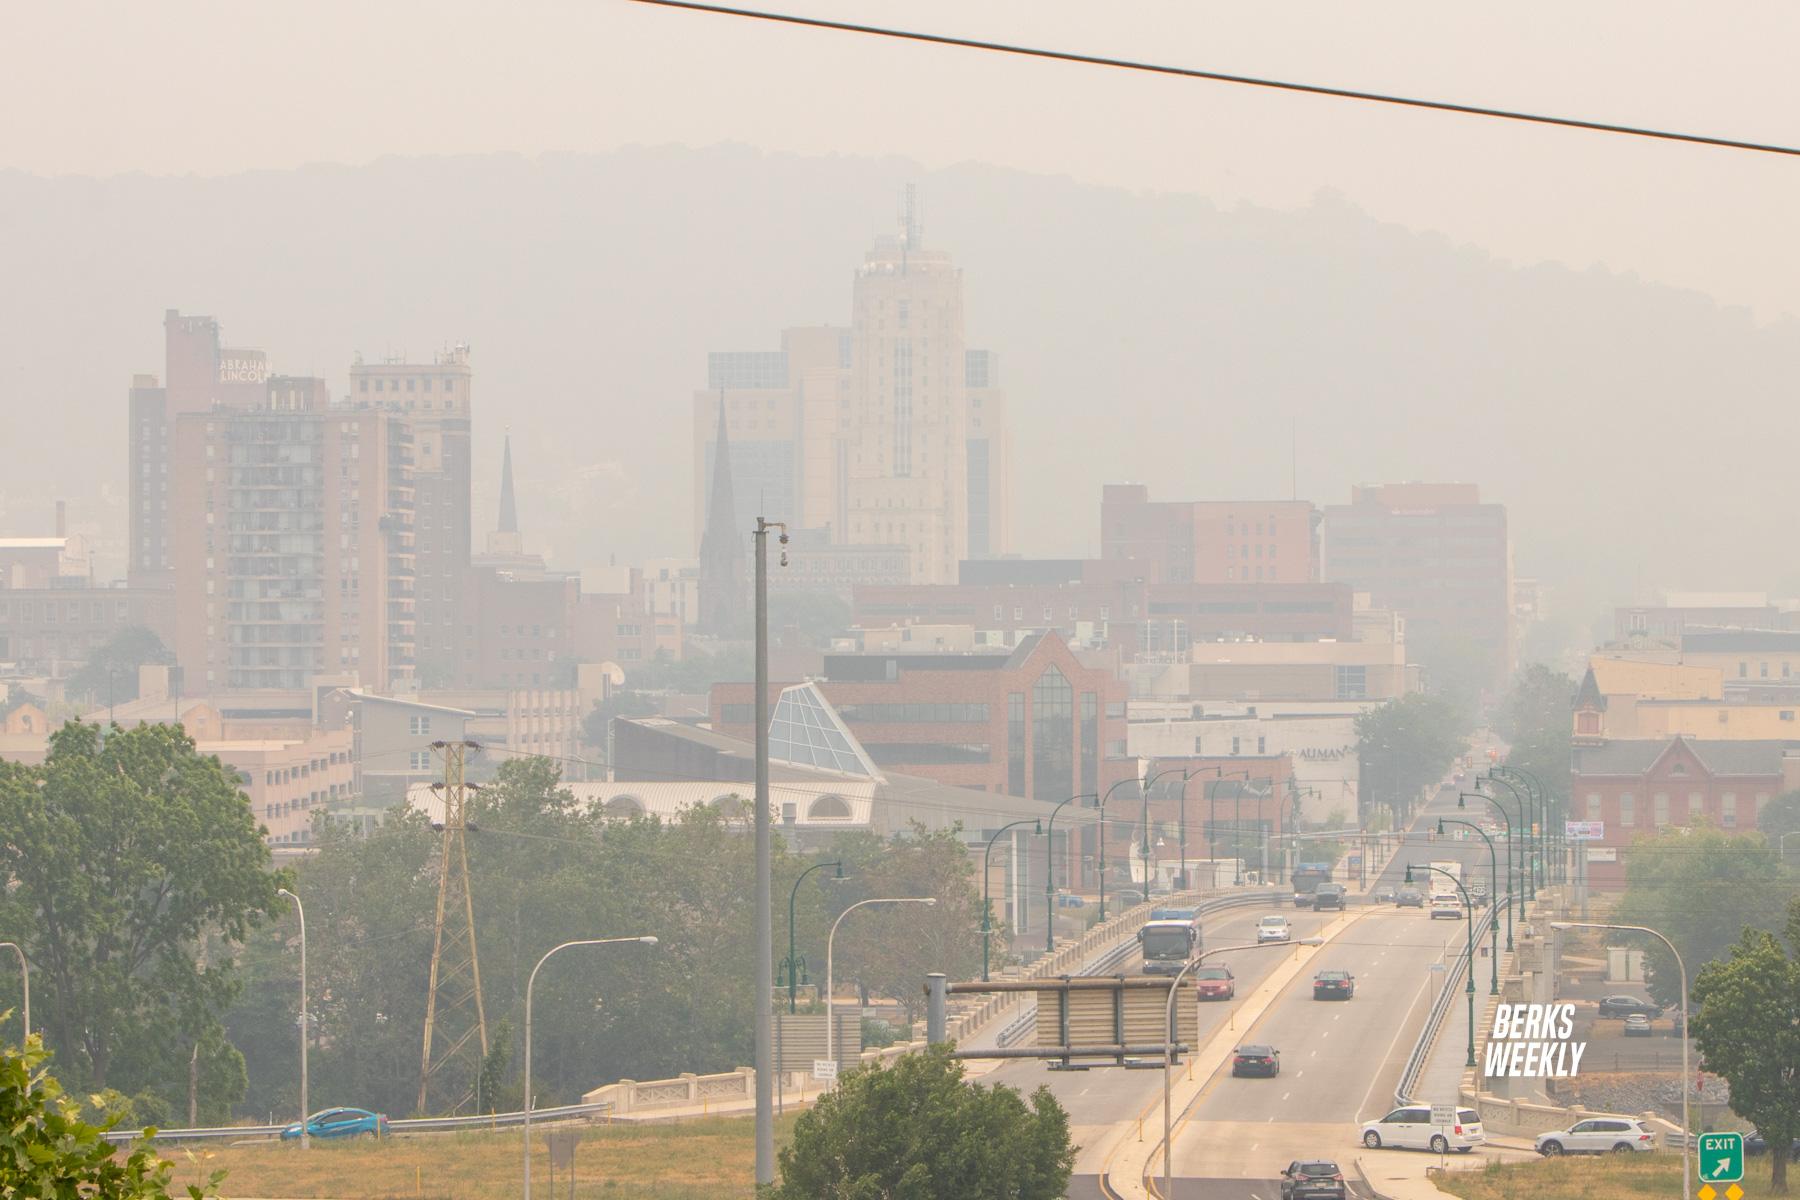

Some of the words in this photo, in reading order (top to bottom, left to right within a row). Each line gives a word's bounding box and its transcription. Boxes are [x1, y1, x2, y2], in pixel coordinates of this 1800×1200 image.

[219, 359, 273, 371] ABRAHAM
[222, 370, 272, 384] LINCOLN
[1705, 1138, 1735, 1150] EXIT
